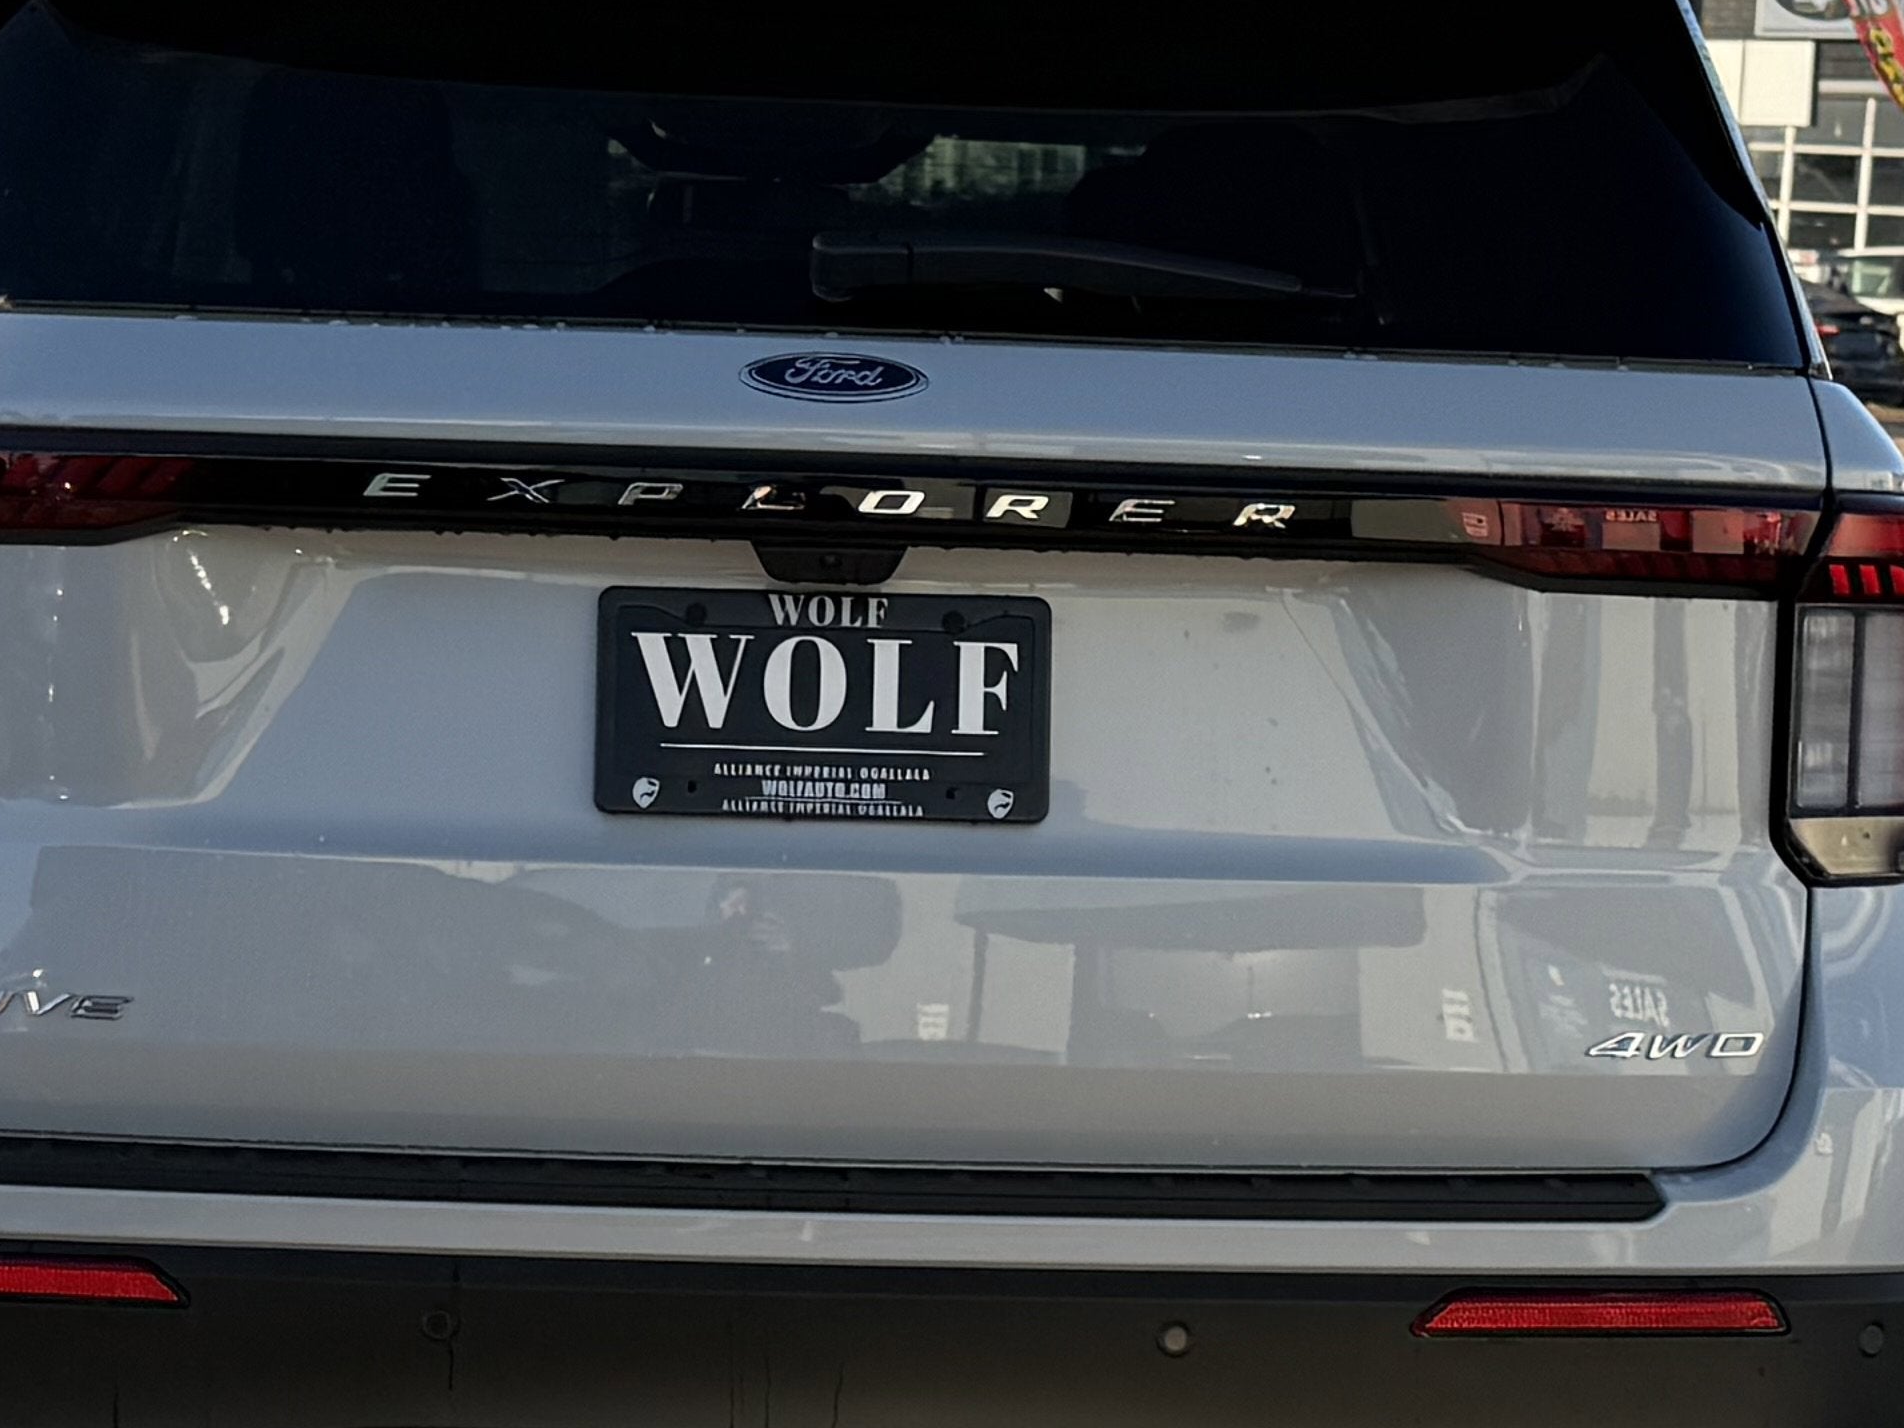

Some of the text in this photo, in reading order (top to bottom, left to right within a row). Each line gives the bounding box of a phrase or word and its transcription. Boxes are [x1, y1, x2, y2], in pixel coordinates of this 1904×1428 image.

[784, 358, 885, 386] Ford
[363, 473, 1297, 530] EXPLORER
[767, 593, 889, 628] WOLF
[630, 631, 1019, 736] WOLF
[713, 762, 781, 777] ALLIANCE
[761, 779, 887, 800] WOLFAUTO.COM
[1585, 1031, 1765, 1060] 4WD
